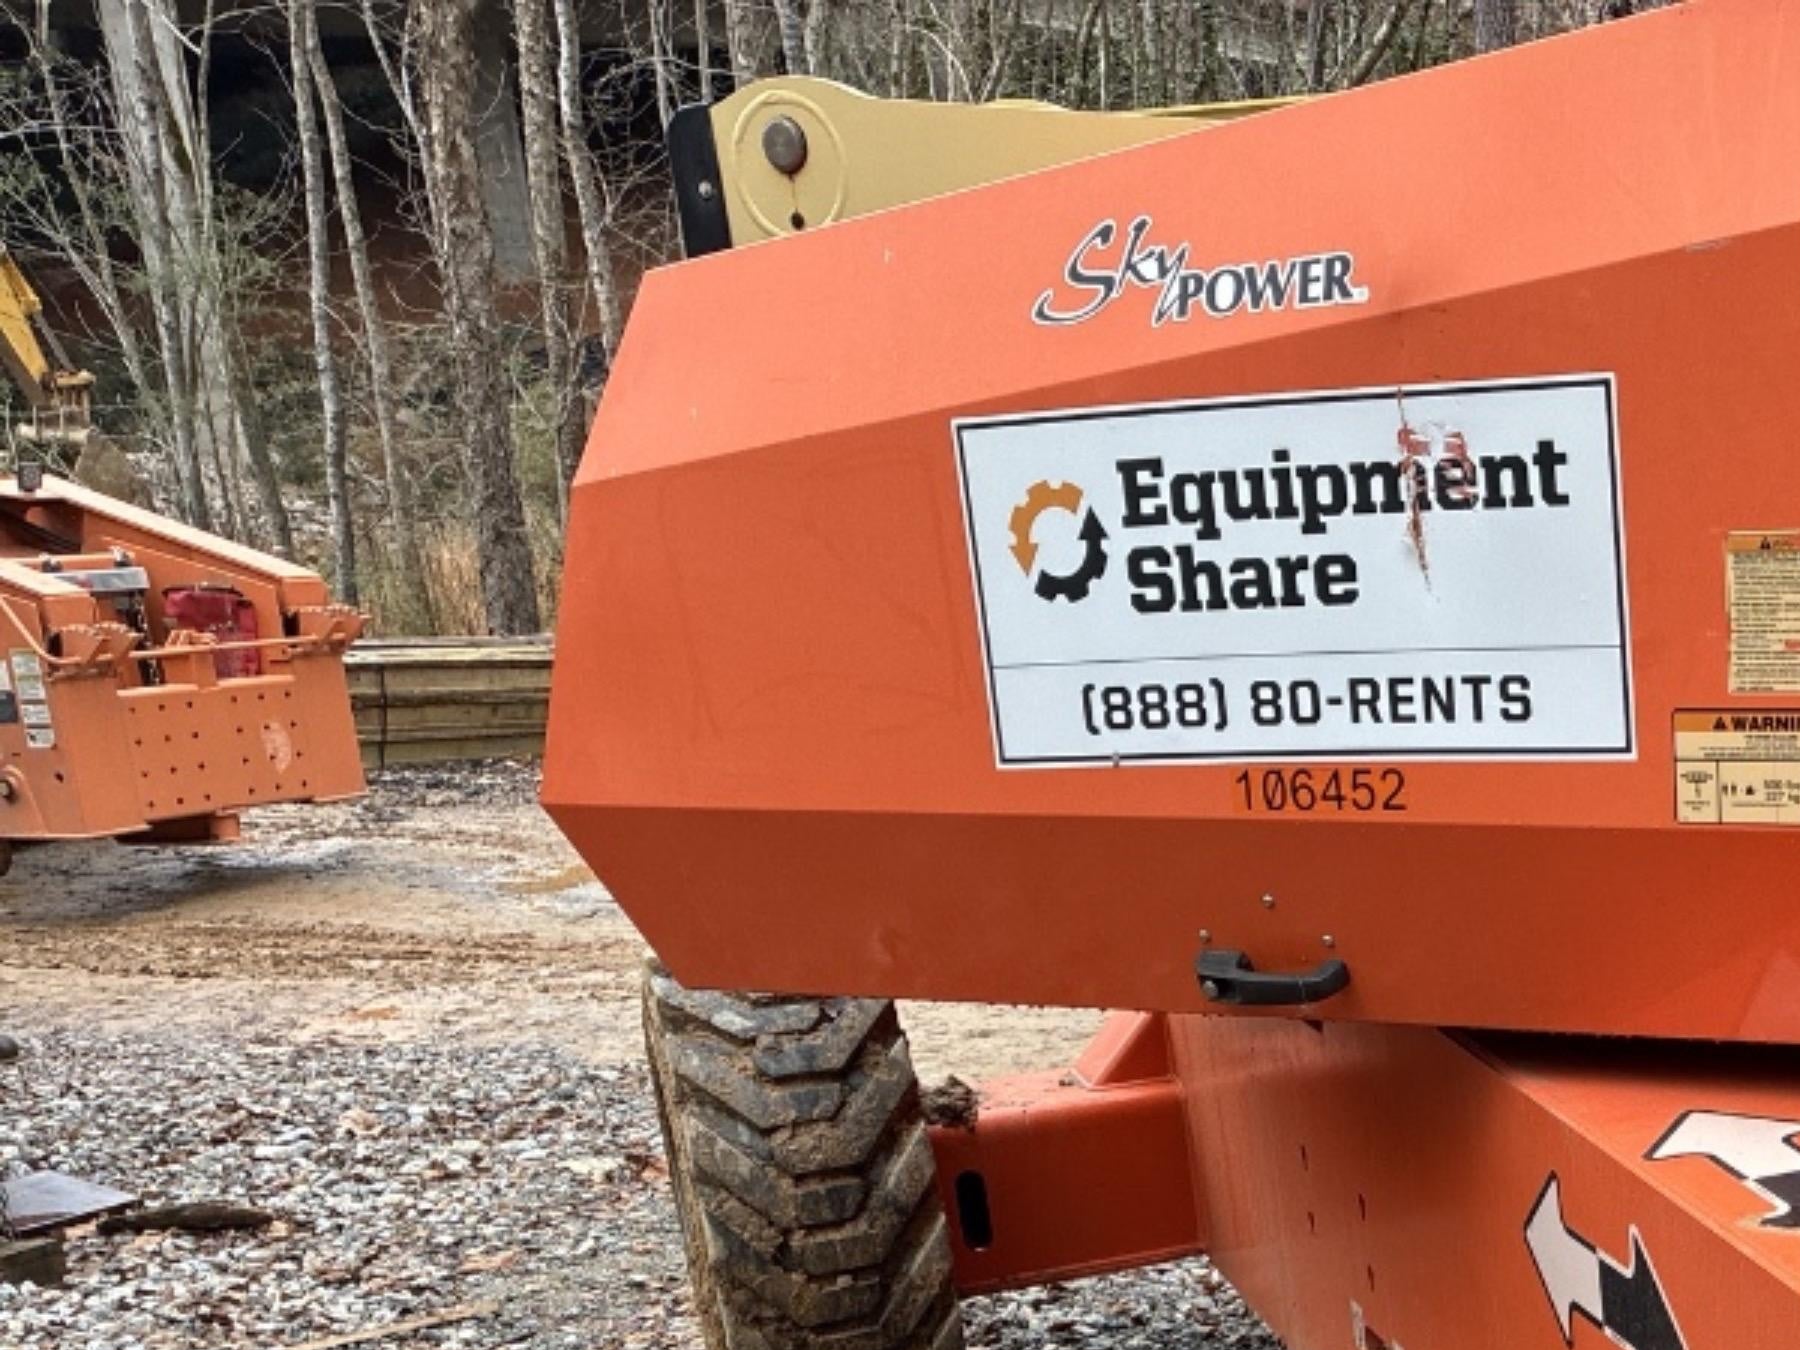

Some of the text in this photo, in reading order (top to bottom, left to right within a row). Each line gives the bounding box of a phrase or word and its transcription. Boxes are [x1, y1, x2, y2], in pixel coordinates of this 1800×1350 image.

[1034, 217, 1355, 325] Sky POWER
[1115, 439, 1570, 538] Equipment
[1127, 545, 1360, 614] Share
[1082, 675, 1533, 735] (888) 80-RENTS
[1234, 769, 1406, 811] 106452
